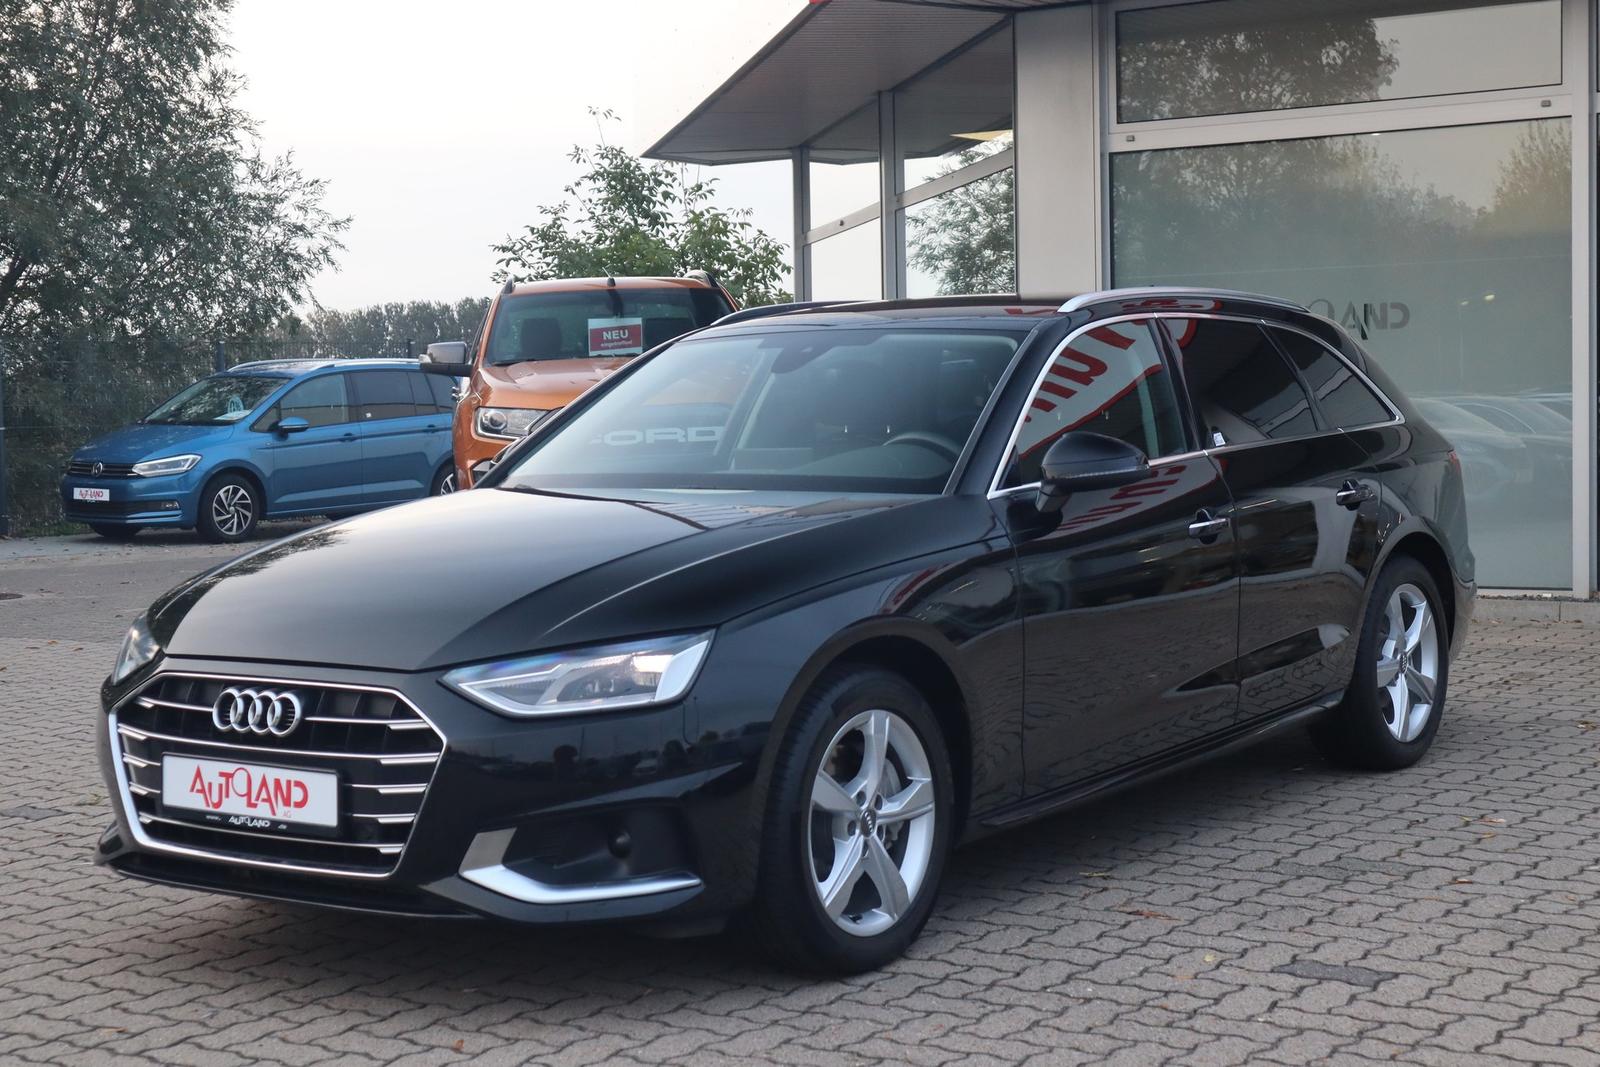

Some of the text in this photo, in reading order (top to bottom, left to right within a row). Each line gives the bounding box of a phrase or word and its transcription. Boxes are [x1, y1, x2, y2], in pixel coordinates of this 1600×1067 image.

[602, 329, 629, 340] NEU
[189, 765, 309, 816] AUTOLAND
[228, 815, 271, 829] AUTOLAND
